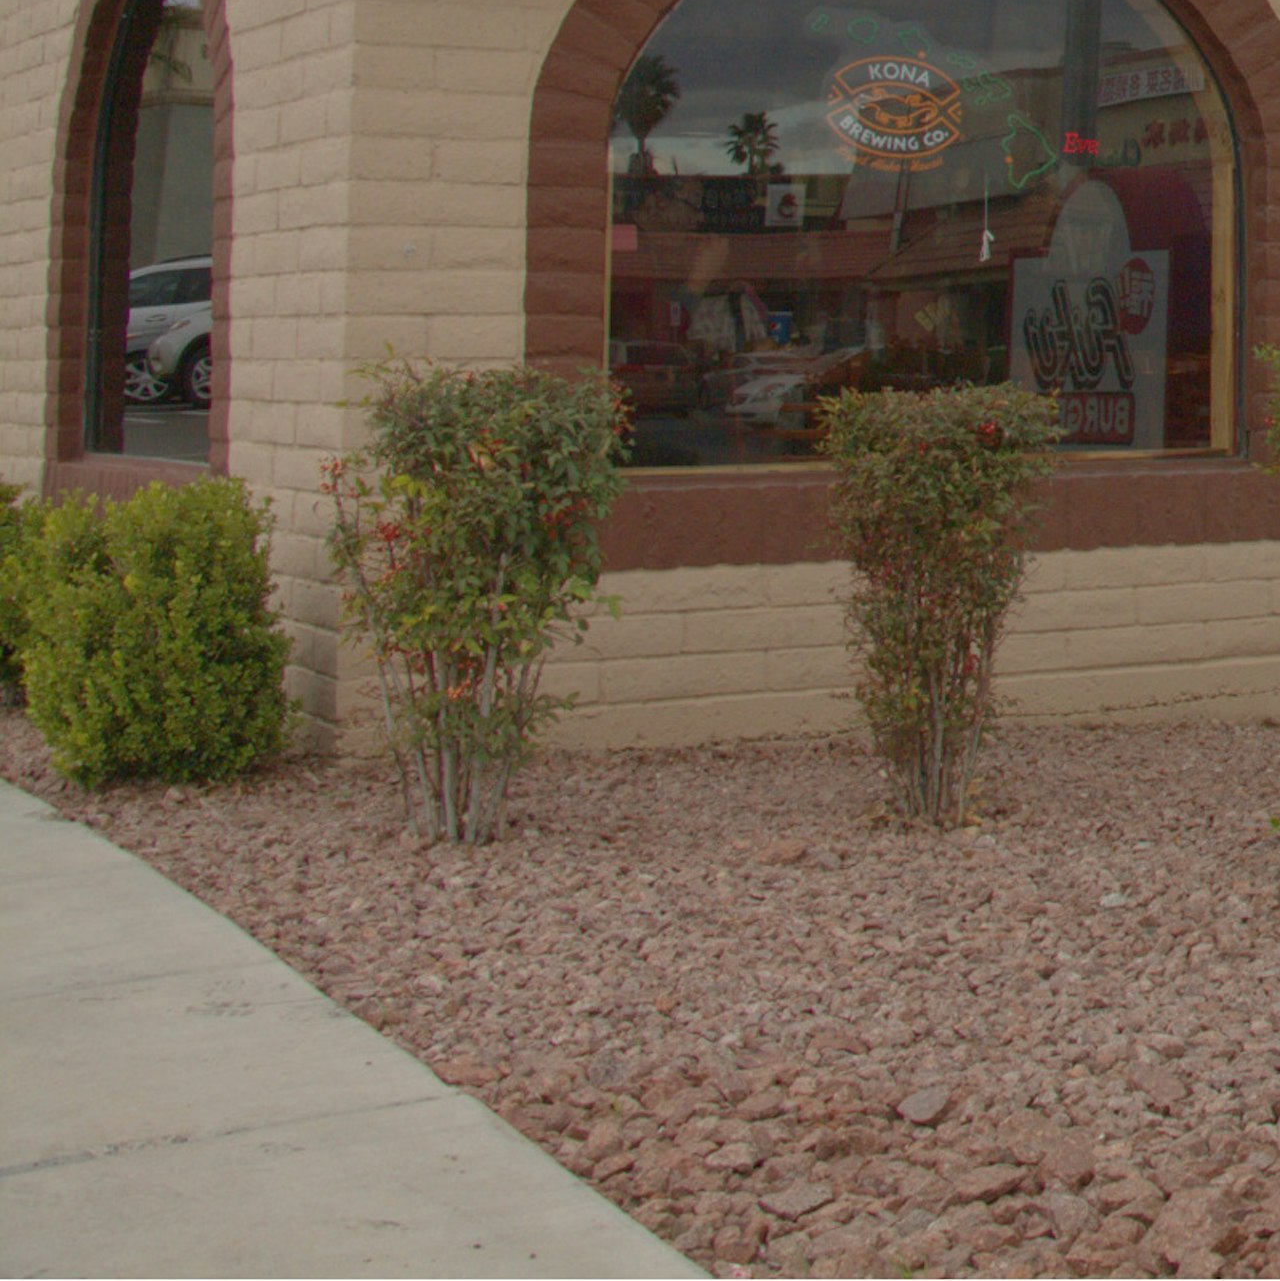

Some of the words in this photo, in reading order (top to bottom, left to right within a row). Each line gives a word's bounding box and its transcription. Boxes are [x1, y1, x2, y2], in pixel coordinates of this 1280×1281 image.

[868, 62, 931, 88] KONA
[839, 115, 919, 152] BREWING
[923, 129, 950, 147] CO.
